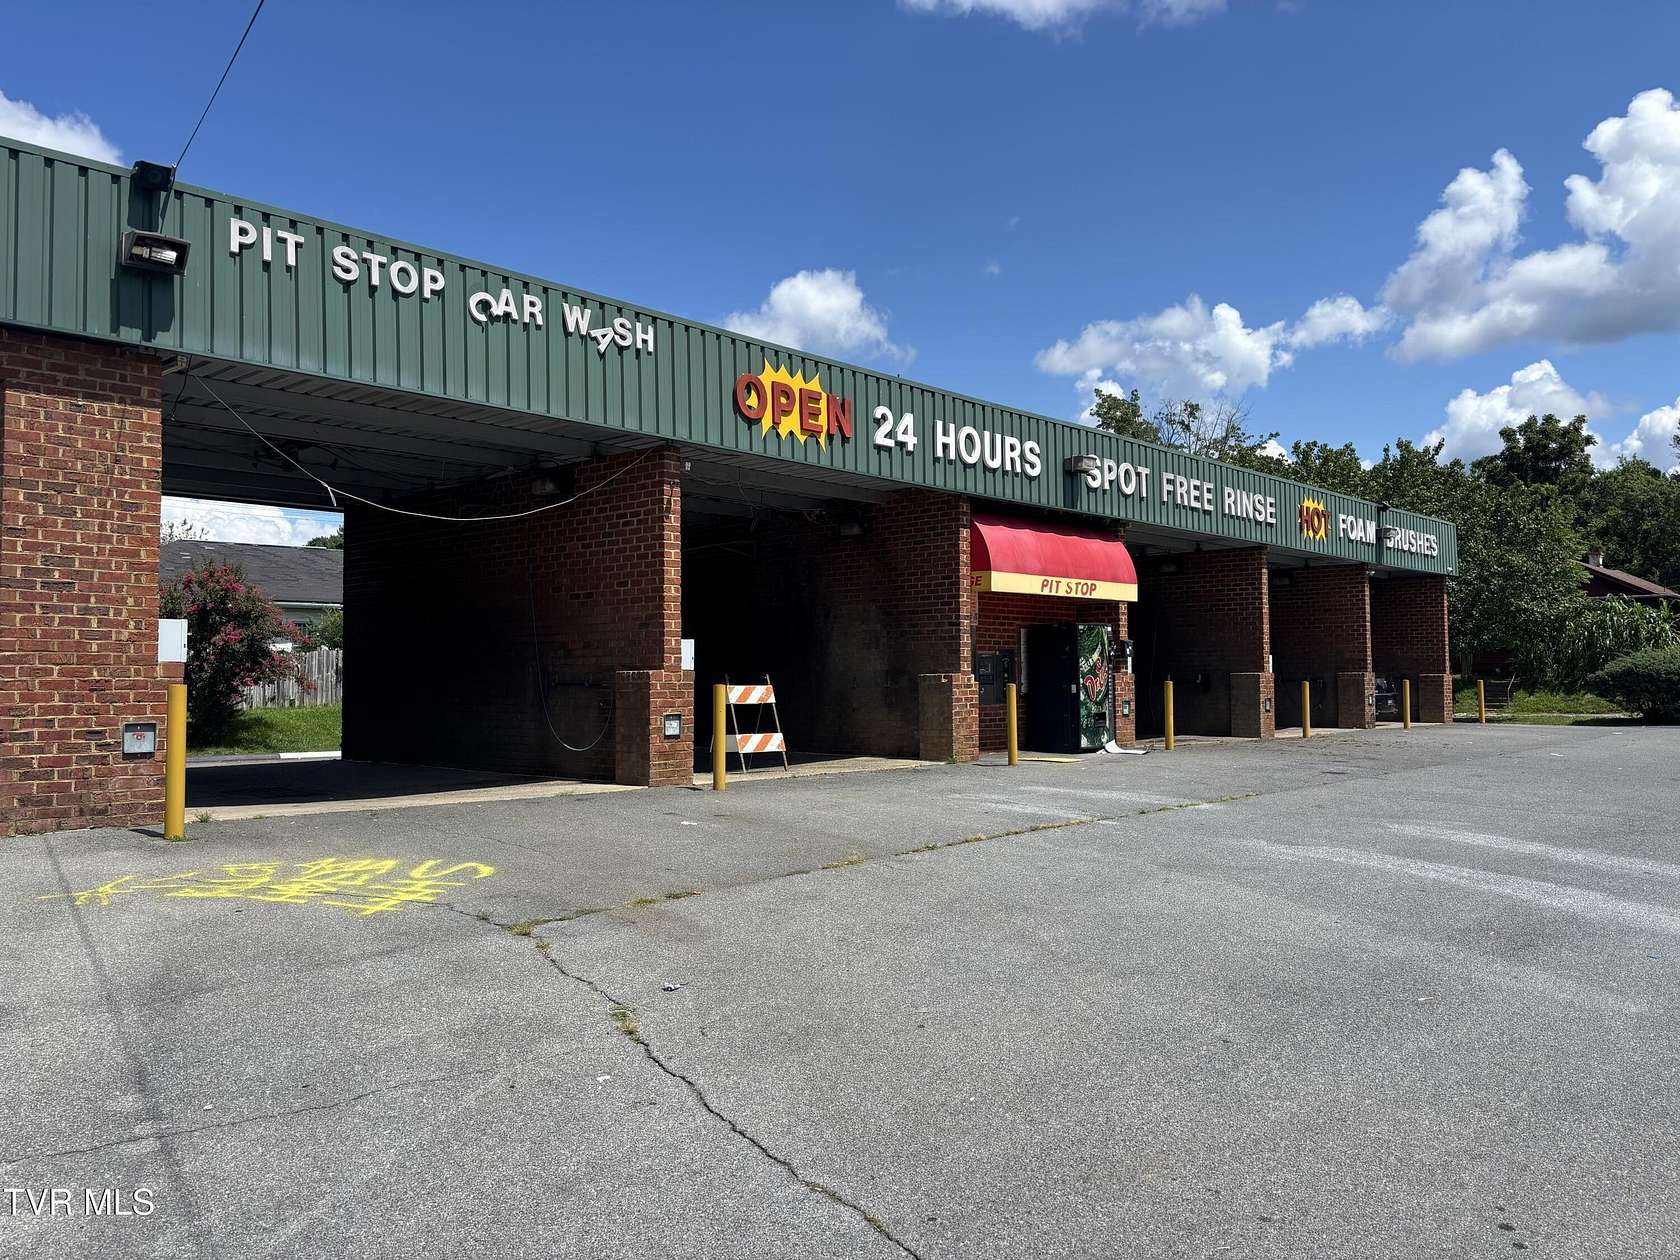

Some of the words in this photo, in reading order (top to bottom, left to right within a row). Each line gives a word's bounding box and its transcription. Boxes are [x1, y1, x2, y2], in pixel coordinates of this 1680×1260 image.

[229, 217, 304, 267] PIT
[332, 245, 445, 300] STOP
[468, 288, 543, 326] CAR
[562, 303, 654, 354] WASH
[734, 373, 852, 438] OPEN
[873, 405, 918, 452] 24
[935, 419, 1041, 477] HOURS
[1086, 454, 1150, 498] SPOT
[1162, 471, 1214, 512] FREE
[1224, 486, 1277, 524] RINSE
[1299, 503, 1331, 538] HOT
[1339, 513, 1376, 544] FOAM
[1041, 578, 1062, 594] PIT
[1065, 581, 1097, 596] STOP
